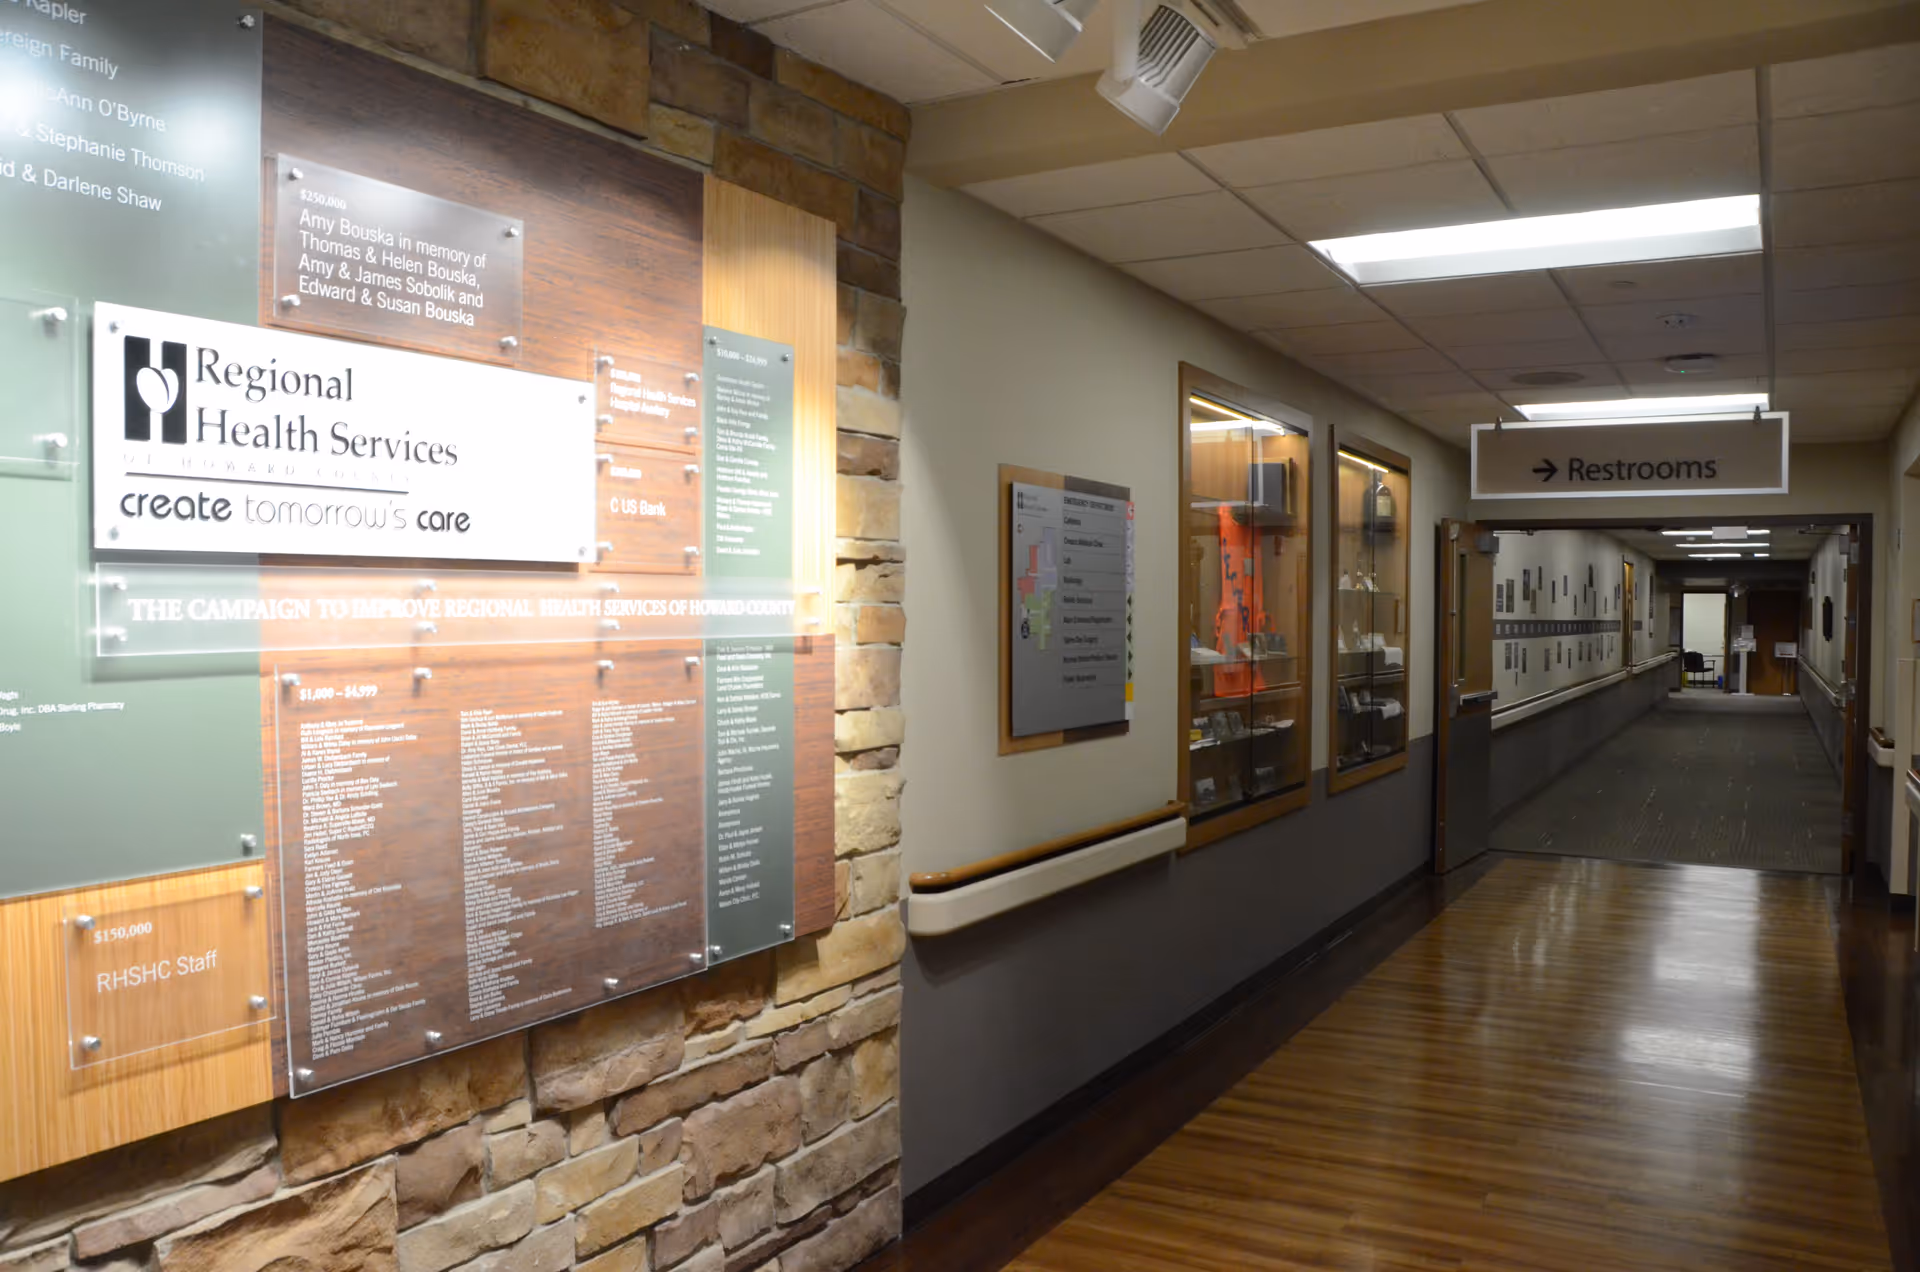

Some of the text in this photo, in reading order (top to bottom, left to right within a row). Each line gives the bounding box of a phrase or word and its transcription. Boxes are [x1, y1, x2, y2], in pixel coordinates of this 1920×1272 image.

[60, 44, 119, 79] Family
[98, 98, 167, 133] O'Byrne
[35, 122, 126, 162] Stephanie
[131, 147, 205, 183] Thomson
[22, 163, 37, 184] &
[44, 168, 112, 200] Darlene
[117, 186, 162, 212] Shaw
[300, 189, 346, 210] $250,000
[299, 208, 487, 269] Amy Bouska in memory of
[299, 231, 481, 290] Thomas & Helen Bouska,
[298, 253, 483, 308] Amy & James Sobolik and
[299, 275, 474, 327] Edward & Susan Bouska
[195, 346, 354, 404] Regional
[195, 407, 459, 467] Health Services
[1569, 457, 1717, 481] Restrooms
[120, 491, 471, 533] create tomorrow's care
[640, 500, 666, 516] Bank
[127, 598, 796, 621] THE CAMPAIGN TO IMPROVE REGIONAL HEALTH SERVICES OF HOWARD COUNTY
[94, 921, 153, 944] $150,000
[97, 948, 217, 993] RHSHC Staff
